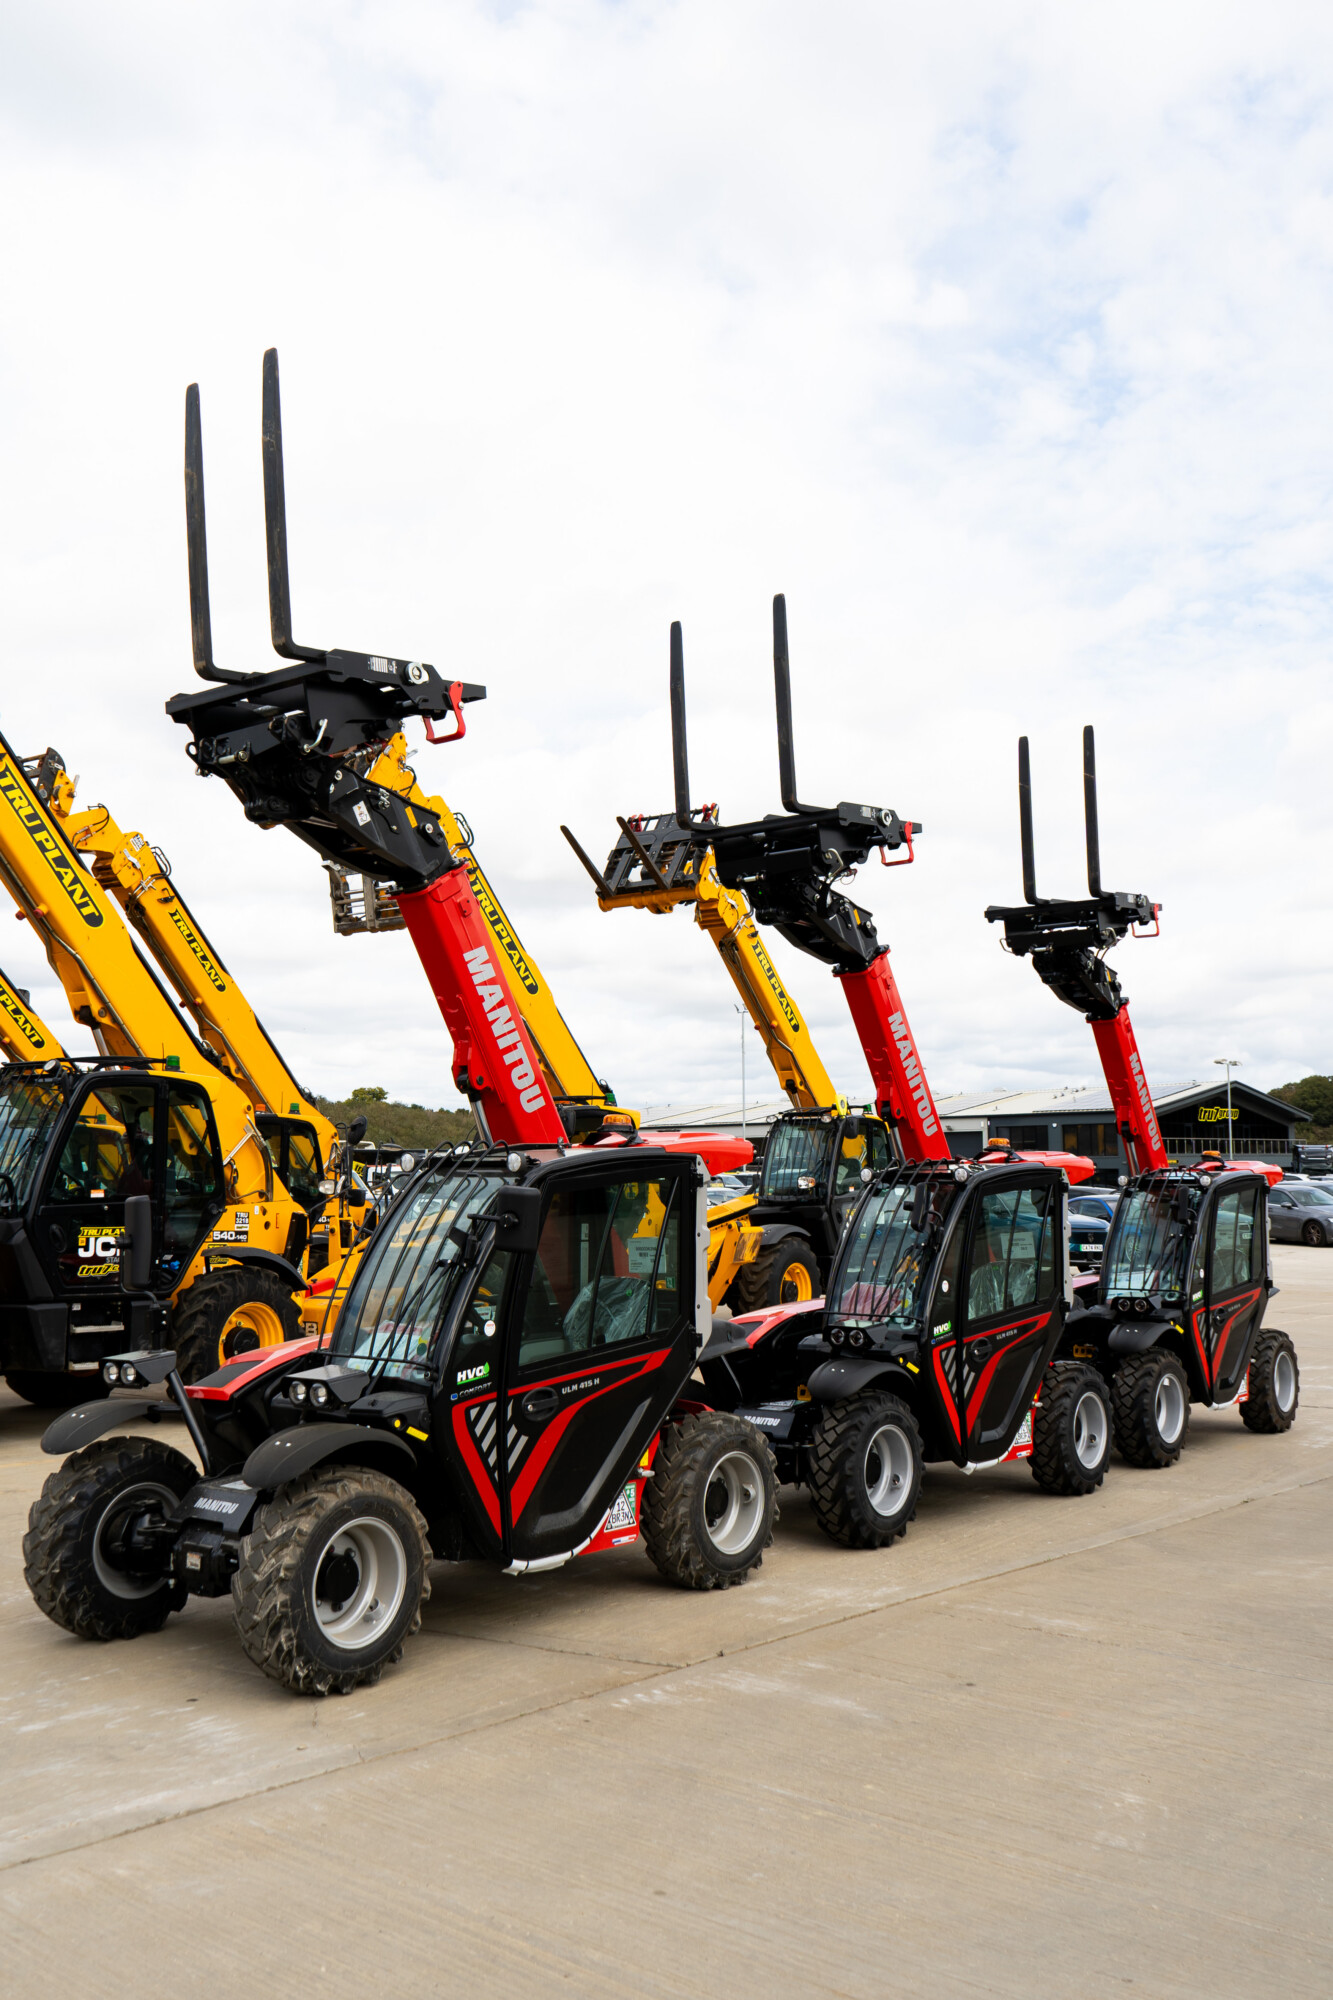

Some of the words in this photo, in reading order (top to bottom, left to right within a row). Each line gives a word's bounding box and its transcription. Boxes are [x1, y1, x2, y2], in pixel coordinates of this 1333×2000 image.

[0, 771, 42, 828] TRU
[33, 829, 100, 918] PLANT
[172, 911, 194, 941] TRU
[189, 941, 224, 987] PLANT
[471, 879, 499, 922] TRU
[494, 922, 536, 990] PLANT
[754, 943, 773, 977] TRU
[770, 976, 797, 1027] PLANT
[0, 993, 43, 1043] PLANT
[462, 945, 546, 1114] MANITOU
[887, 1010, 939, 1137] MANITOU
[1128, 1051, 1162, 1151] MANITOU
[78, 1236, 120, 1258] JC
[83, 1228, 101, 1236] TRU
[101, 1228, 125, 1236] PLA
[456, 1365, 486, 1383] HVO
[459, 1382, 493, 1398] COMFORT
[561, 1383, 578, 1395] ULM
[579, 1379, 593, 1389] 415
[593, 1377, 600, 1385] H
[193, 1497, 240, 1515] MANITOU
[616, 1500, 625, 1512] 12
